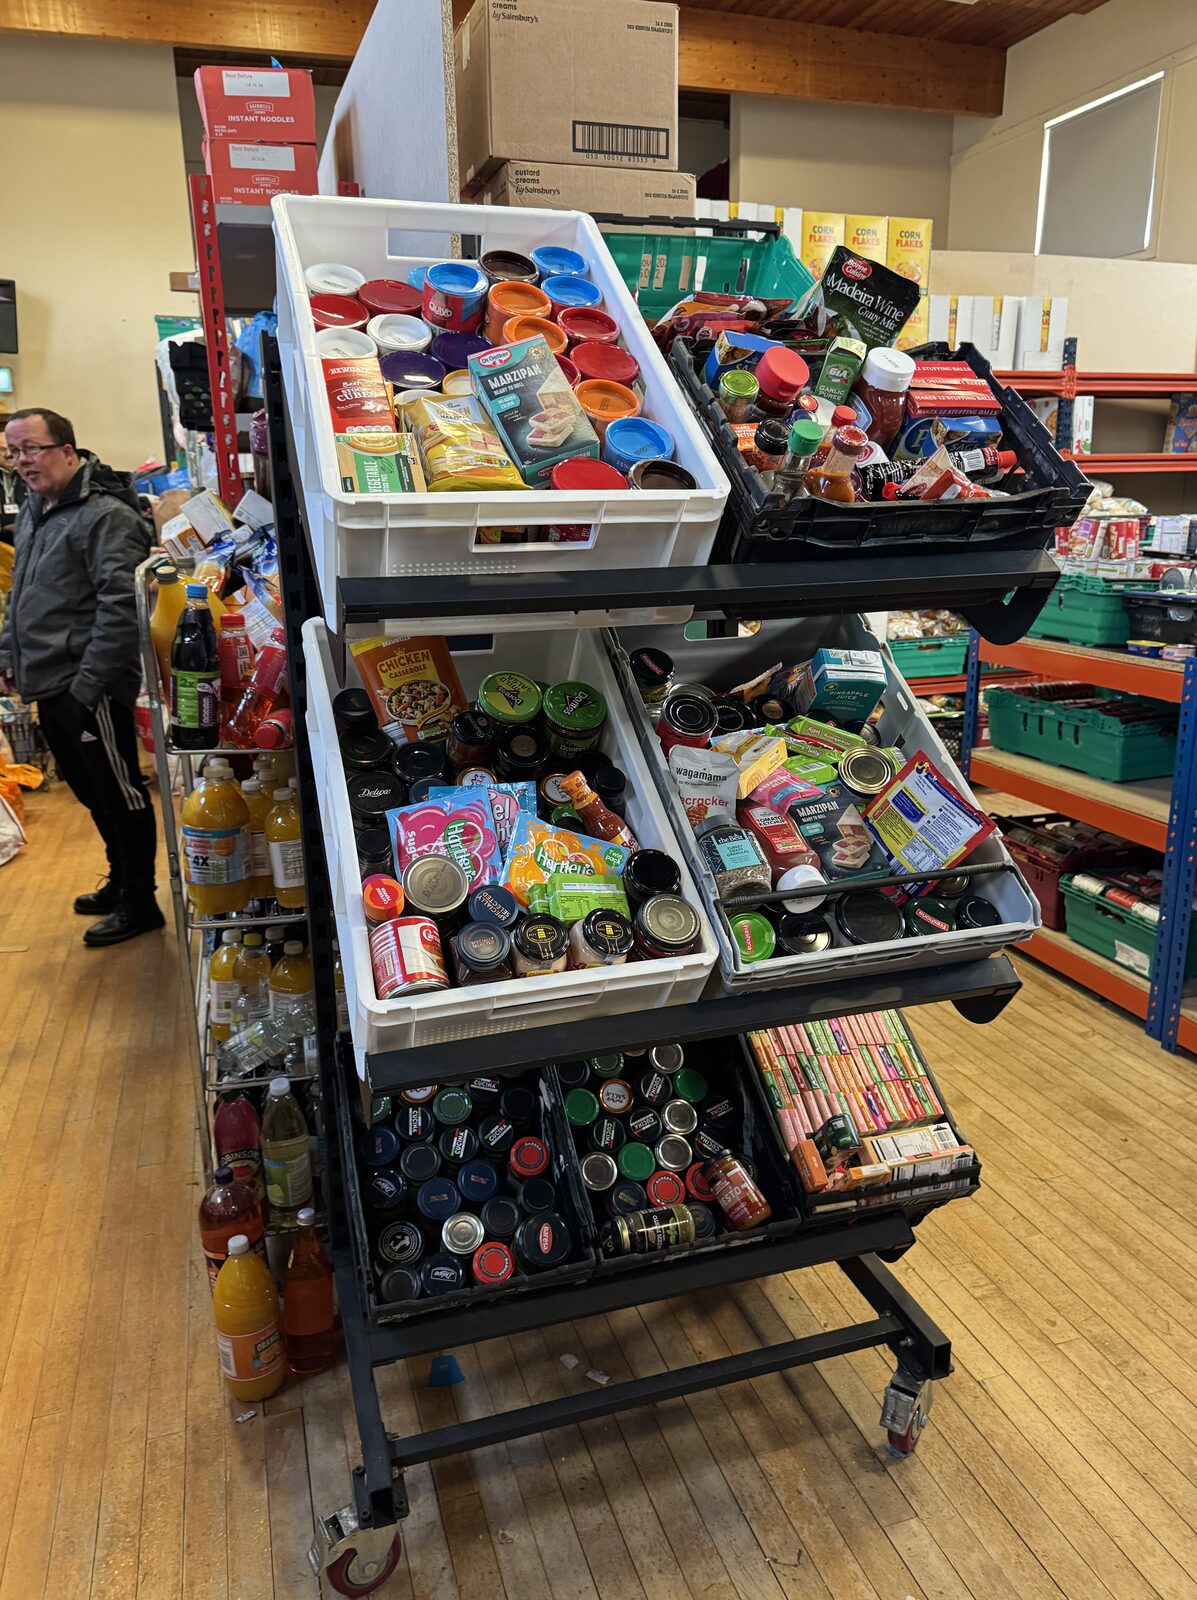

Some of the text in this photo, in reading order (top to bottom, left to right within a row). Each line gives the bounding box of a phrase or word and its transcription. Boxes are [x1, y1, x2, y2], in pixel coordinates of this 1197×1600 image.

[492, 2, 517, 11] creams
[502, 13, 538, 24] Sainsbury's
[515, 169, 540, 177] custard
[525, 186, 560, 196] Sainsbury's
[813, 226, 834, 234] CORN
[856, 228, 878, 236] CORN
[899, 230, 921, 240] CORN
[809, 234, 837, 244] FLAKES
[852, 236, 880, 246] FLAKES
[896, 239, 924, 248] FLAKES
[828, 272, 904, 322] Madeira Wine
[428, 304, 452, 318] QUIXO
[858, 306, 897, 331] Gravy Mix
[488, 364, 542, 390] MARZIPAN
[819, 385, 845, 396] GARLIC
[364, 460, 382, 492] VEGETABLE
[378, 650, 430, 674] CHICKEN
[388, 664, 428, 679] CASSEROLE
[500, 676, 521, 690] MILD
[508, 676, 533, 692] SALSA
[496, 686, 522, 706] Doritos
[564, 690, 590, 716] Doritos
[676, 766, 727, 782] wagamama
[358, 788, 391, 798] Deluxe
[680, 796, 728, 808] ecracker
[796, 800, 840, 818] MARZIPAN
[756, 816, 784, 824] TOMATO
[758, 818, 786, 827] KETCHUP
[718, 836, 729, 844] the
[606, 855, 621, 866] pack
[608, 850, 622, 858] Twin
[475, 895, 507, 922] SPECIALLY
[482, 891, 512, 918] SELECTED
[918, 910, 948, 930] Freshona
[742, 921, 754, 952] Freshona
[474, 1080, 496, 1089] CUCINA
[650, 1076, 662, 1098] CUCINA
[632, 1118, 654, 1130] CUCINA
[488, 1124, 508, 1142] CUCINA
[454, 1132, 466, 1156] CUCINA
[700, 1136, 720, 1152] CUCINA
